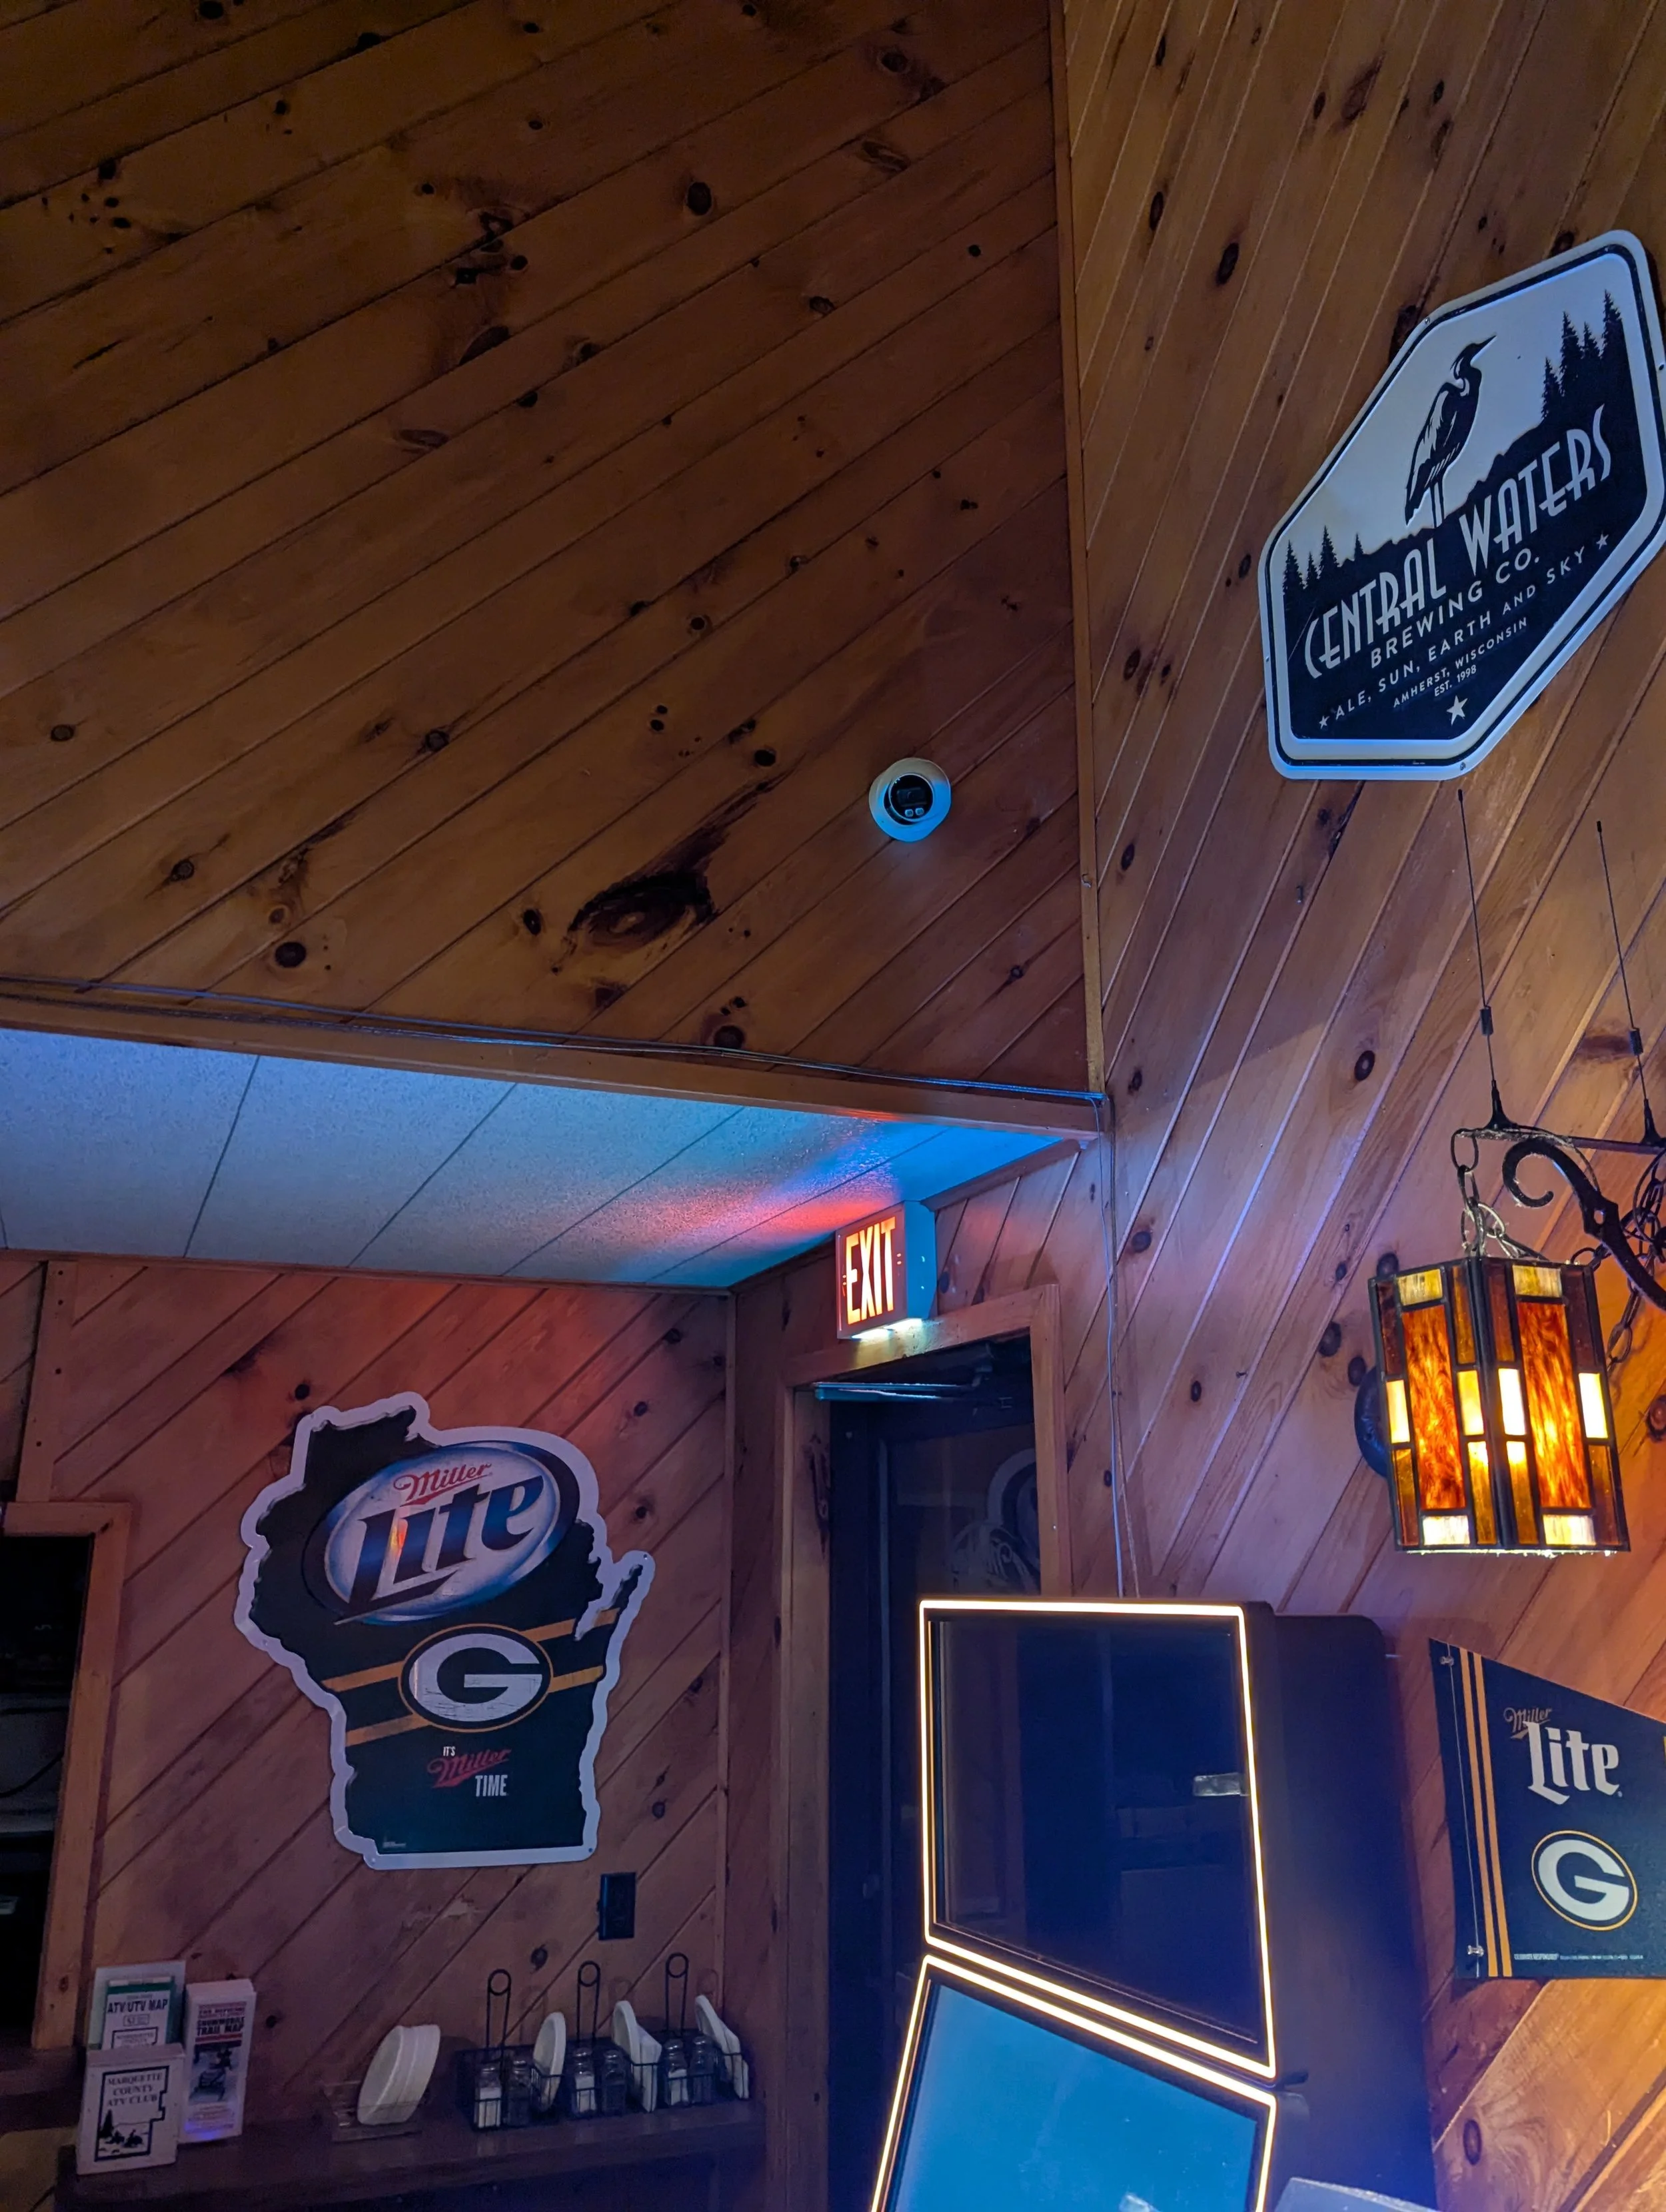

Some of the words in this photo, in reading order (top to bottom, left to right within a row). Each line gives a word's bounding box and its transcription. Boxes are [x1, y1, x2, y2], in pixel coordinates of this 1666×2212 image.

[1304, 537, 1447, 680] CENTRAL
[1458, 402, 1611, 577] WATERS
[1371, 580, 1483, 669] BREWING
[1495, 548, 1540, 584] CO.
[1335, 690, 1371, 721] ALE,
[1377, 660, 1421, 693] SUN,
[1427, 610, 1491, 663] EARTH
[1501, 584, 1536, 616] AND
[1546, 545, 1585, 585] SKY
[1393, 666, 1451, 708] AMHERST,
[1454, 616, 1527, 670] WISCONSIN
[1433, 679, 1453, 698] EST.
[1456, 664, 1477, 684] 1998
[844, 1216, 896, 1326] EXIT
[393, 1463, 492, 1508] Miller
[336, 1474, 545, 1624] Lite
[409, 1632, 543, 1723] G
[1503, 1706, 1553, 1740] Miller
[426, 1748, 512, 1789] Miller
[442, 1746, 456, 1757] IT'S
[1525, 1720, 1621, 1806] Lite
[474, 1774, 508, 1798] TIME
[1538, 1839, 1630, 1922] G
[149, 1998, 169, 2011] MAP
[107, 2072, 163, 2085] MARQUETTE
[107, 2097, 127, 2107] ATV
[129, 2093, 158, 2105] CLUB
[113, 2083, 154, 2096] COUNTY
